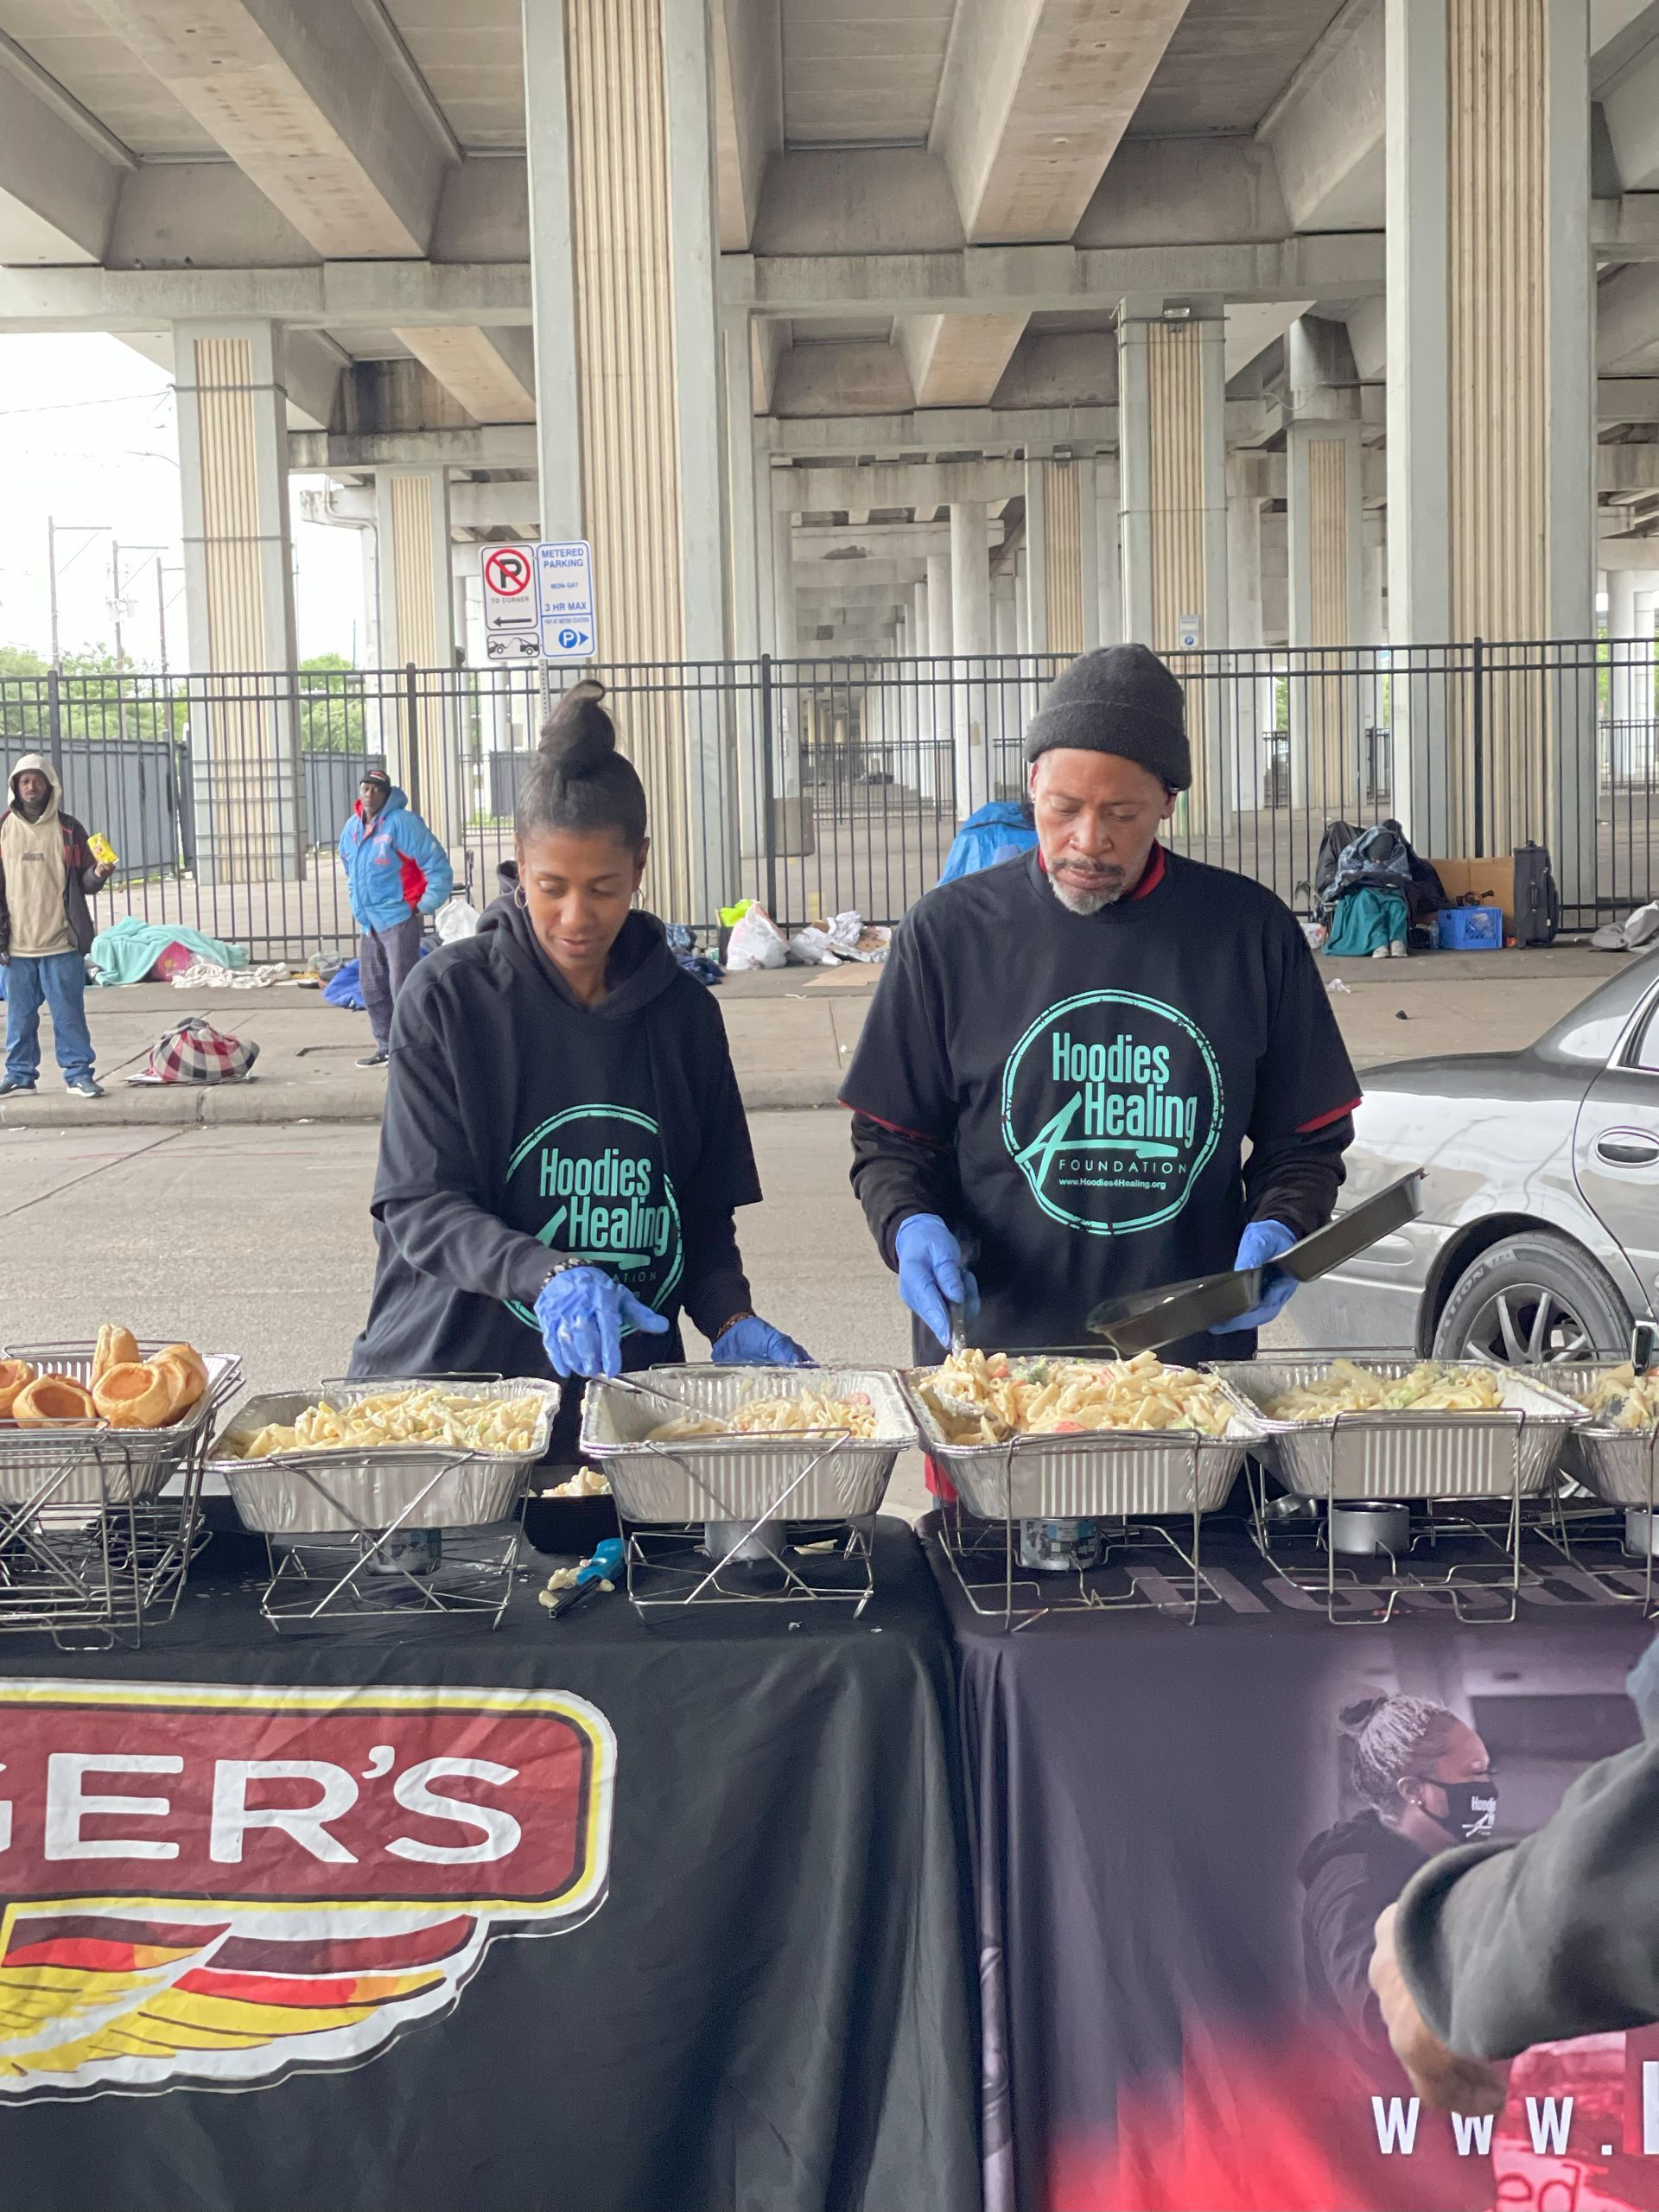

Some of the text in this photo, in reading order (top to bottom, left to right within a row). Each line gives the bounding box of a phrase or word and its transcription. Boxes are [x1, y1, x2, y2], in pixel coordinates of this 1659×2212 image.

[542, 548, 584, 557] METERED
[543, 559, 584, 569] PARKING
[544, 601, 587, 612] 3 HR MAX
[563, 632, 575, 646] P
[1052, 1033, 1170, 1084] Hoodies
[1084, 1082, 1198, 1149] Healing
[539, 1147, 651, 1197] Hoodies
[1058, 1159, 1186, 1174] FOUNDATION
[1058, 1177, 1166, 1190] www.Hoodies4Healing.org
[569, 1196, 670, 1257] Healing
[0, 1745, 522, 1865] ER'S
